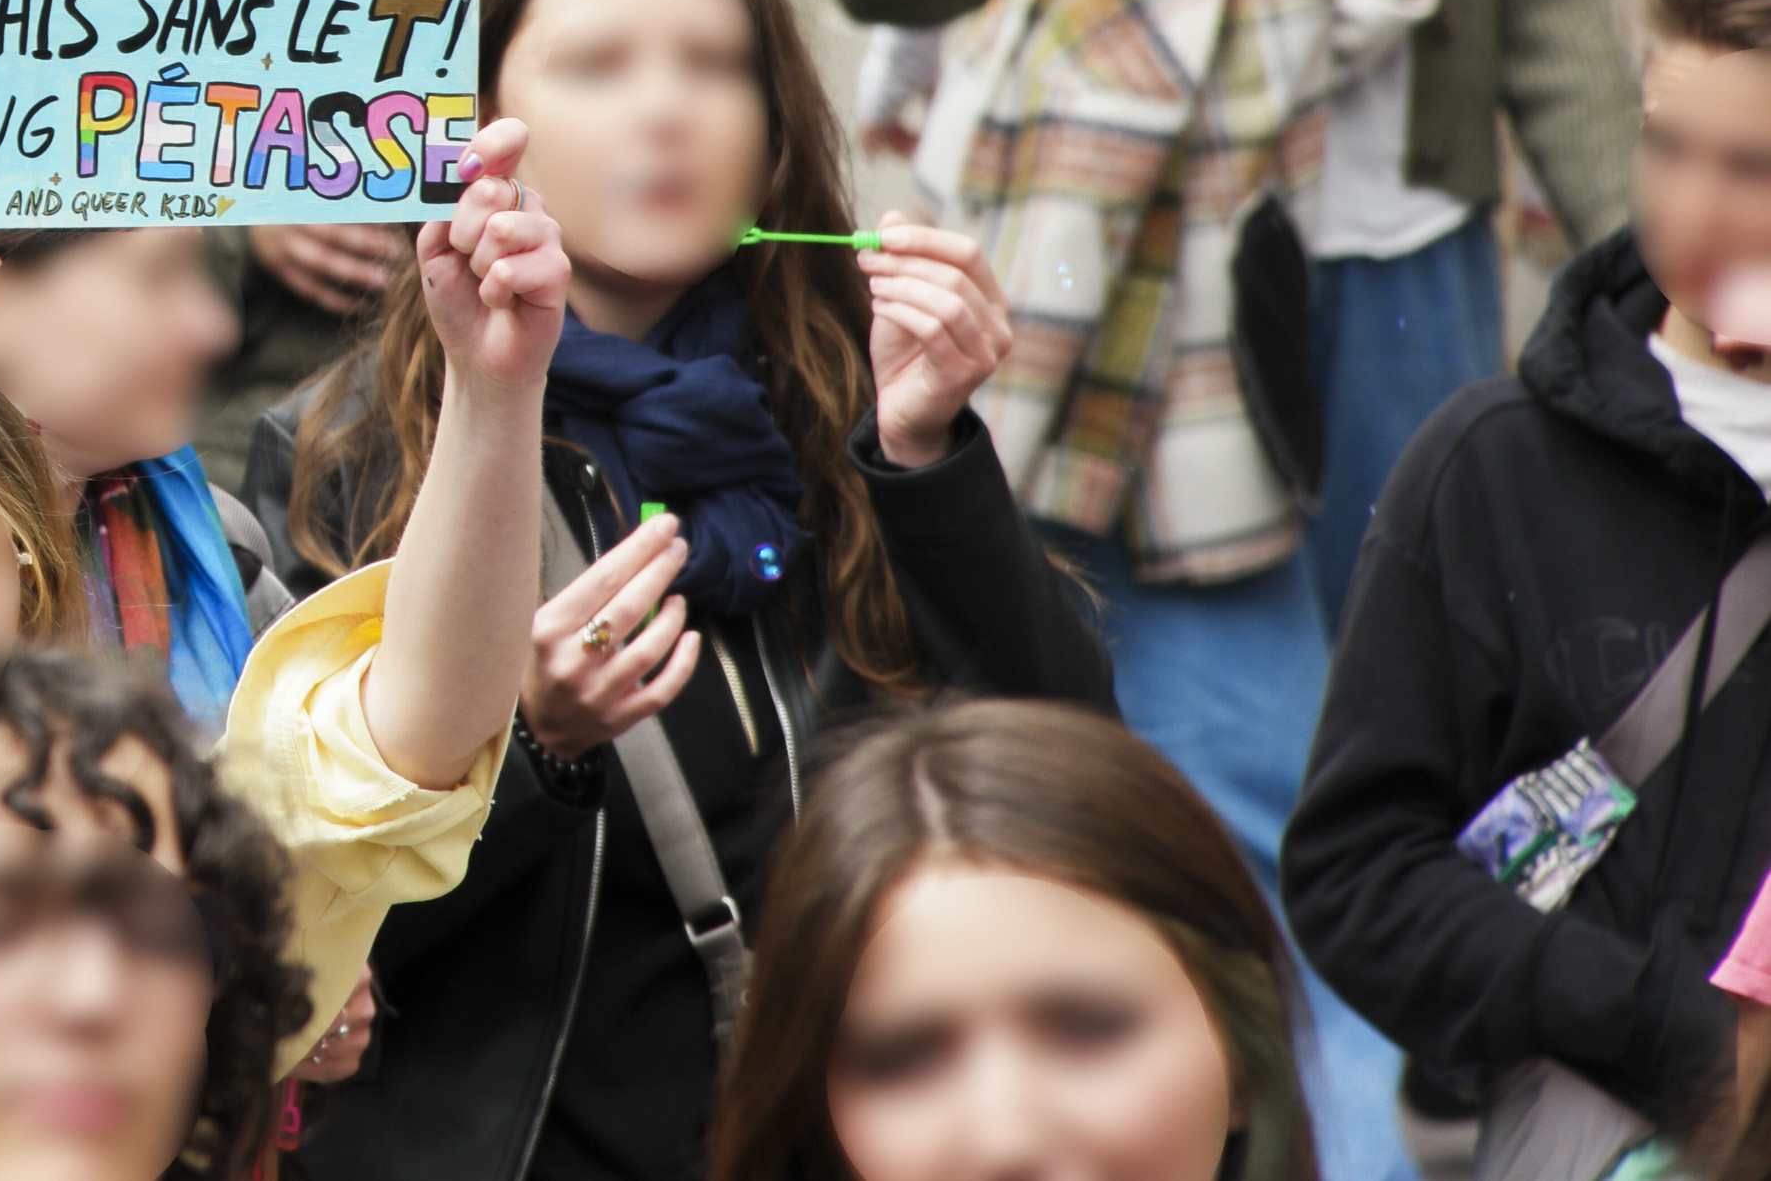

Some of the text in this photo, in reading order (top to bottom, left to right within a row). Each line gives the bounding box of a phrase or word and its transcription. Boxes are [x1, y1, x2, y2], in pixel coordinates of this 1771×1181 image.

[76, 61, 477, 205] PÉTASSE
[5, 190, 63, 218] AND
[71, 190, 147, 221] QUEER
[159, 193, 218, 221] KIDS
